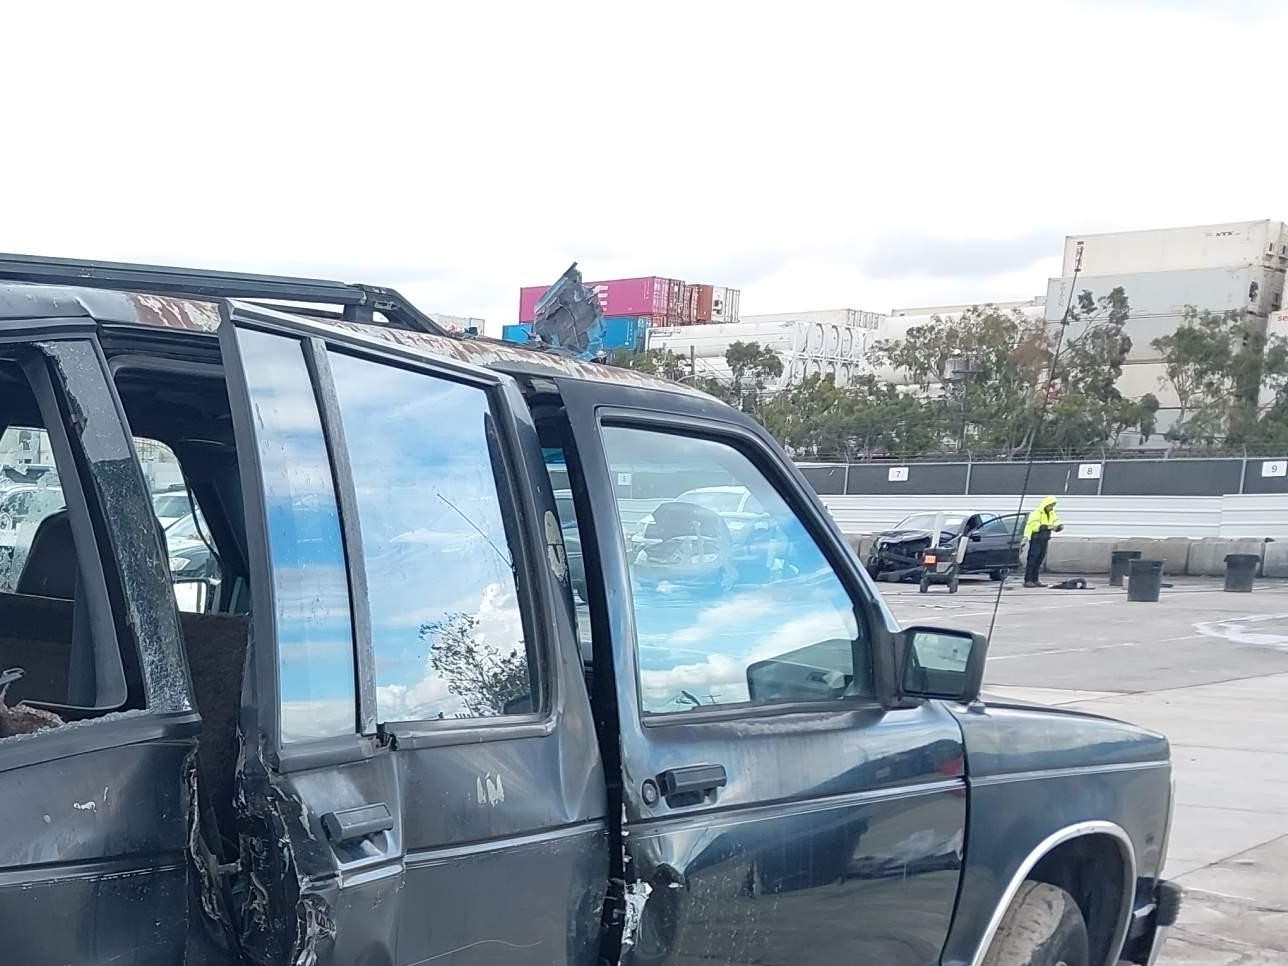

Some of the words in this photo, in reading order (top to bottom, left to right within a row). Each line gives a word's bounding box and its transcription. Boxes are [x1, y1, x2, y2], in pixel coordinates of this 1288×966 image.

[1086, 467, 1093, 476] 8
[1271, 464, 1278, 473] 9
[895, 470, 902, 479] 7
